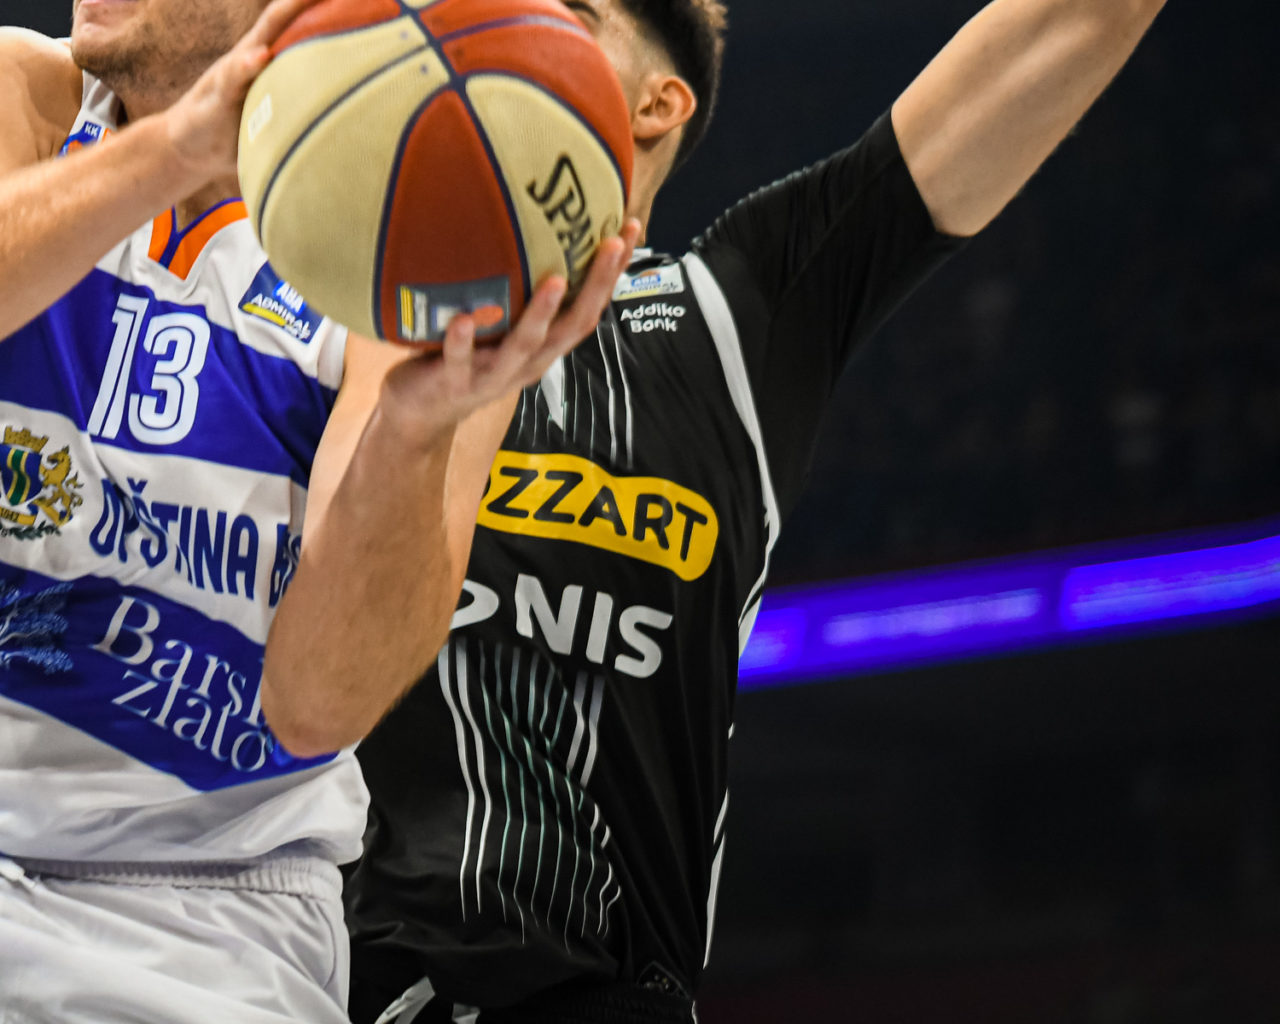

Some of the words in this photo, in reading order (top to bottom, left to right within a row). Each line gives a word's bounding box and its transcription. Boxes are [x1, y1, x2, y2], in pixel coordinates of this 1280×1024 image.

[84, 123, 100, 137] KK
[620, 302, 686, 322] Addiko
[630, 317, 677, 333] Bank
[88, 293, 211, 446] 13
[88, 476, 259, 601] OPŠTINA
[481, 465, 708, 562] ZZART
[514, 573, 673, 678] NIS
[111, 668, 267, 773] zlato
